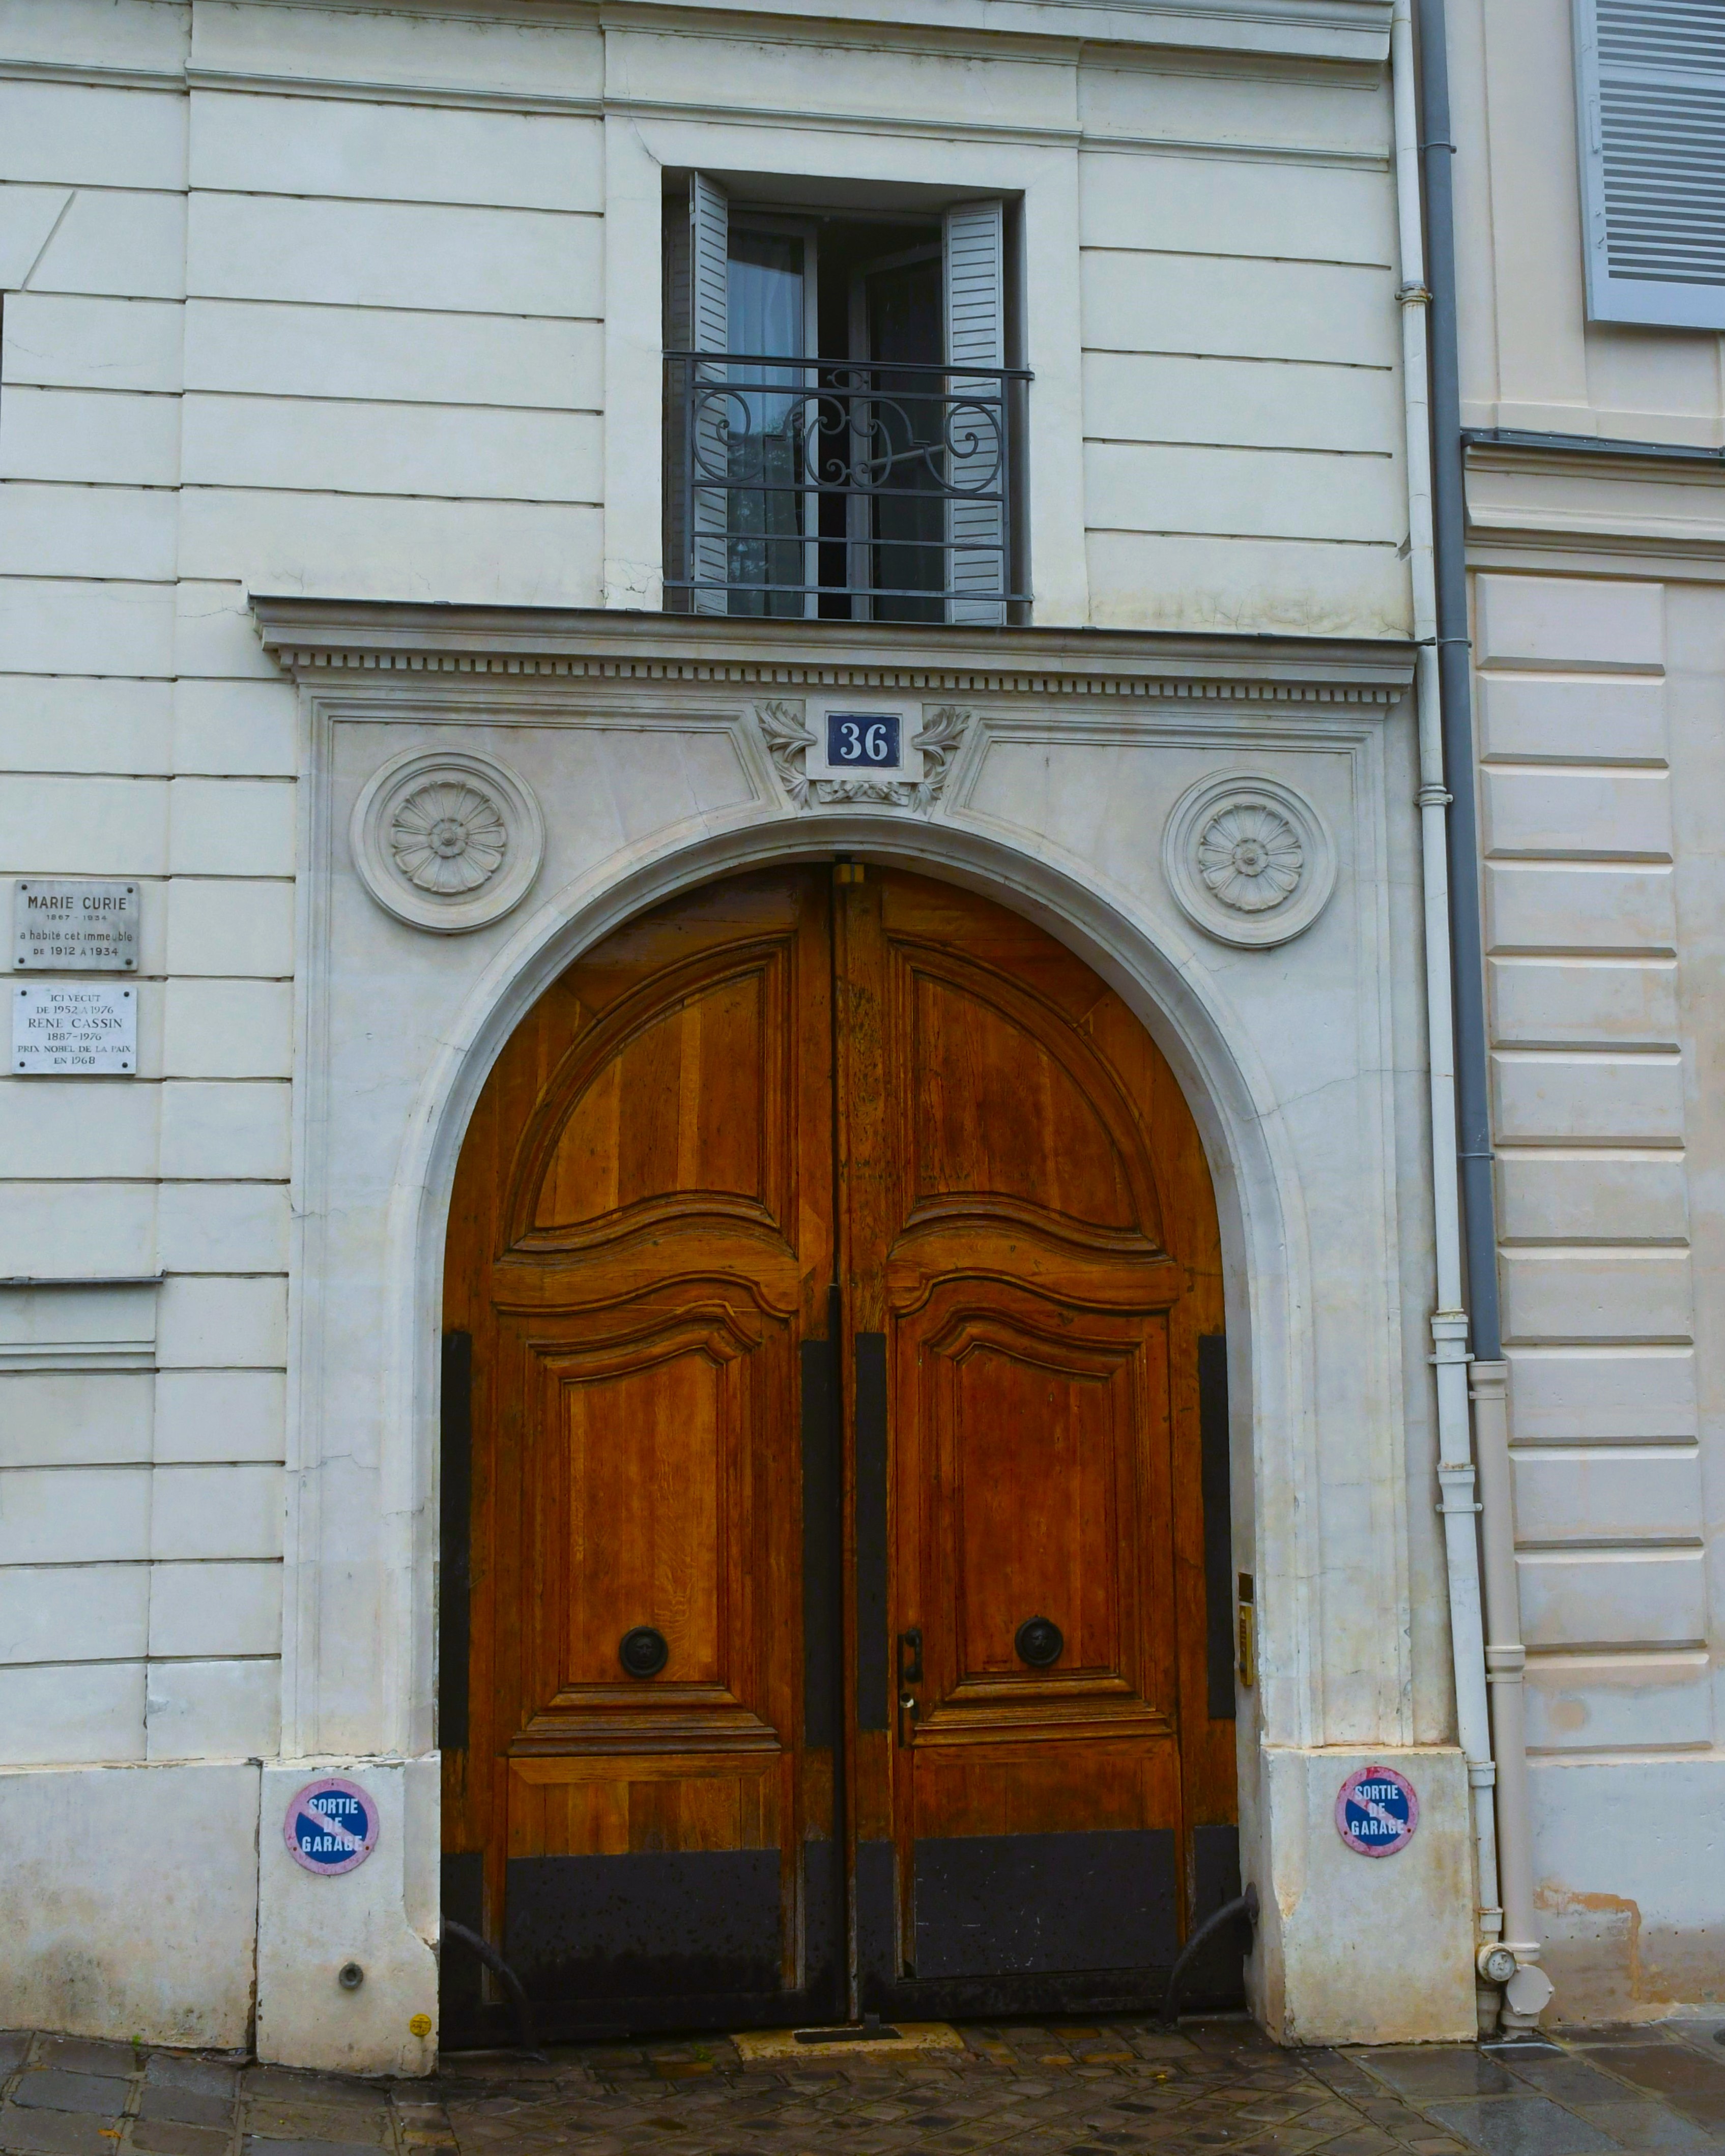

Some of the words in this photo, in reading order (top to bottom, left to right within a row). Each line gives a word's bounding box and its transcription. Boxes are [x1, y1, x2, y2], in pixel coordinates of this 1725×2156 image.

[840, 722, 888, 761] 36
[27, 896, 74, 909] MARIE
[82, 897, 127, 910] CURIE
[30, 929, 61, 940] habité
[64, 931, 80, 941] cet
[84, 931, 133, 942] immeuble
[51, 946, 76, 955] 1912
[90, 947, 119, 956] 1934
[54, 1005, 78, 1014] 1952
[91, 1006, 114, 1014] 1976
[71, 1018, 123, 1028] CASSIN
[71, 1056, 96, 1065] 1968
[1354, 1785, 1399, 1800] SORTIE
[308, 1798, 358, 1814] SORTIE
[1369, 1802, 1386, 1817] DE
[323, 1817, 342, 1833] DE
[1351, 1819, 1404, 1835] GARAGE
[302, 1835, 363, 1852] GARAGE
